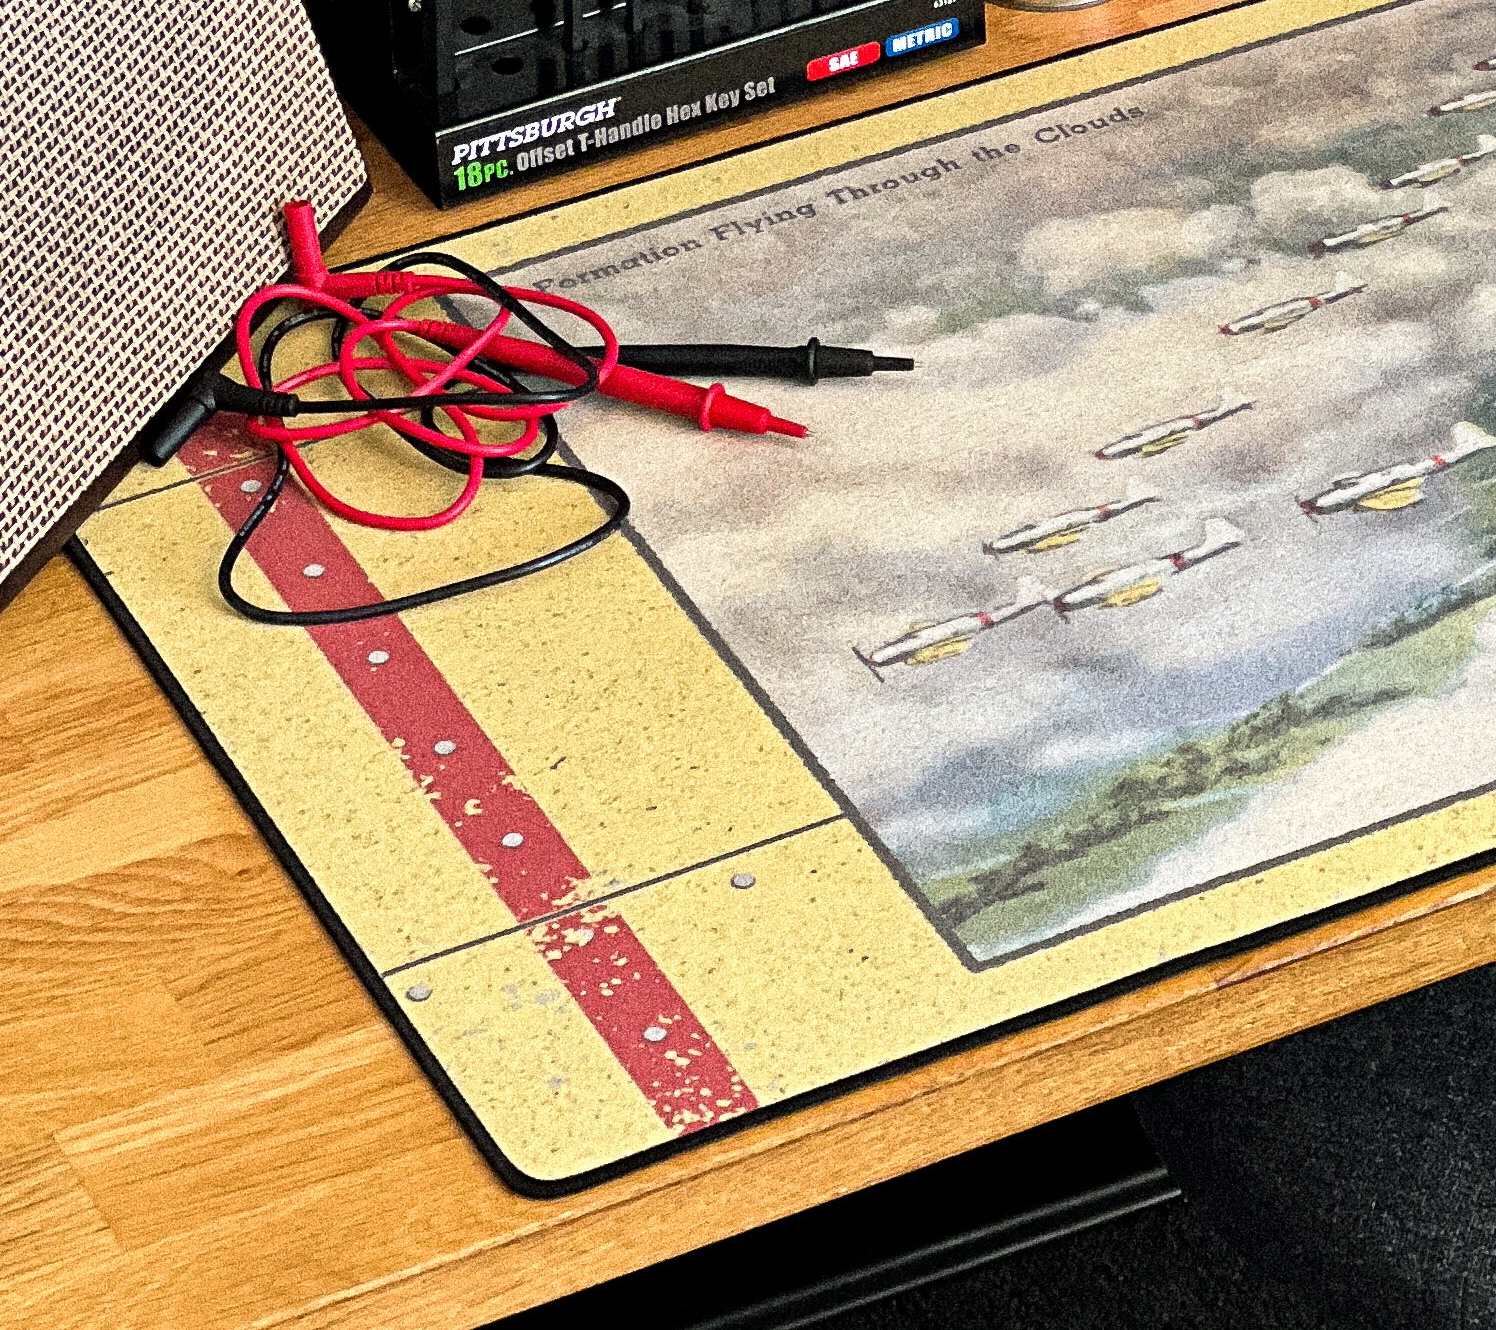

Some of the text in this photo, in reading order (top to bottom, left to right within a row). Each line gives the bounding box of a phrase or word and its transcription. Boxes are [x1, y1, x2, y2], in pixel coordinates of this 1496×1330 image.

[827, 22, 953, 72] SAE METRIC
[451, 97, 618, 166] PITTSBURGH
[516, 138, 575, 172] Offset
[577, 113, 662, 153] T-Handle
[666, 99, 702, 126] Hex
[704, 89, 741, 114] Key
[744, 76, 776, 101] Set
[532, 103, 1146, 292] Formation Flying Through the Clouds
